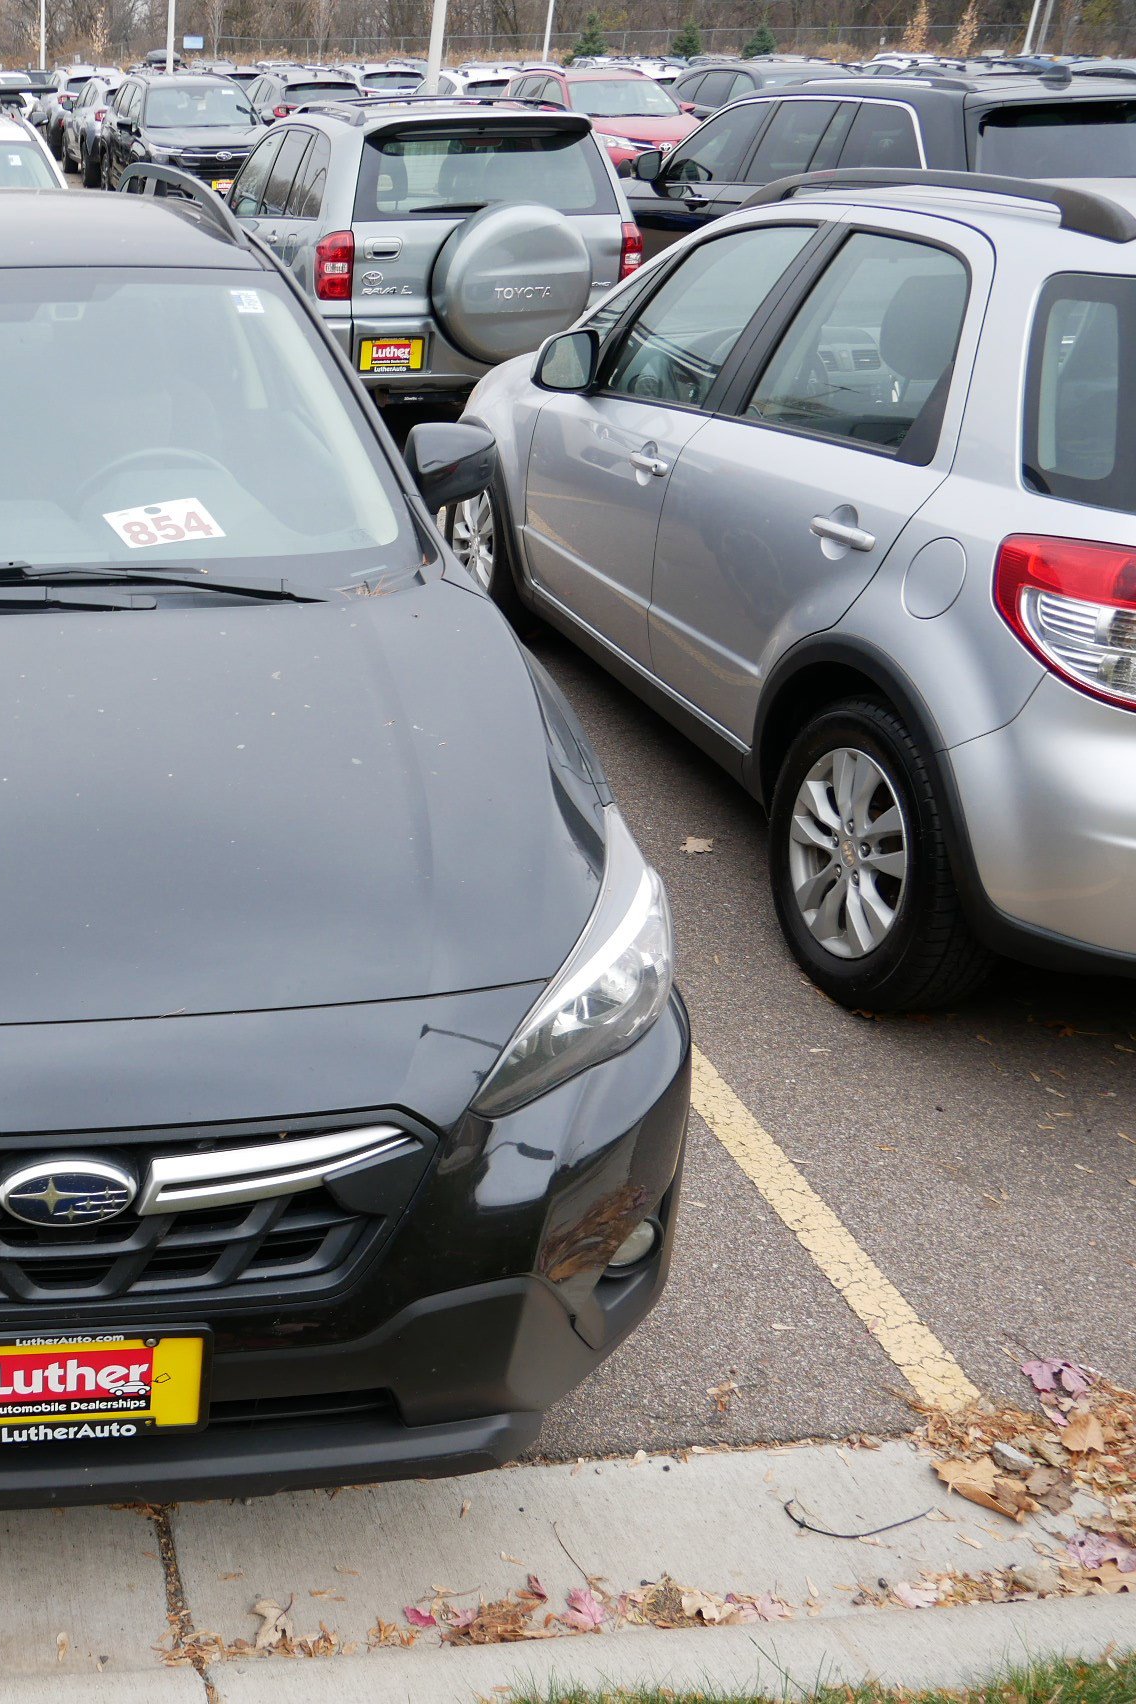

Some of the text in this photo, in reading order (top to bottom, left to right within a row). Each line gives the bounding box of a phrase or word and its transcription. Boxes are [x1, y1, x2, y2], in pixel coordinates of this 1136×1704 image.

[361, 286, 397, 295] RAV4
[494, 286, 552, 300] TOYOTA
[372, 345, 411, 359] Luther
[122, 511, 213, 545] 854
[15, 1334, 125, 1347] LutherAuto.com
[70, 1398, 147, 1411] Dealerships
[1, 1422, 137, 1443] LutherAuto
